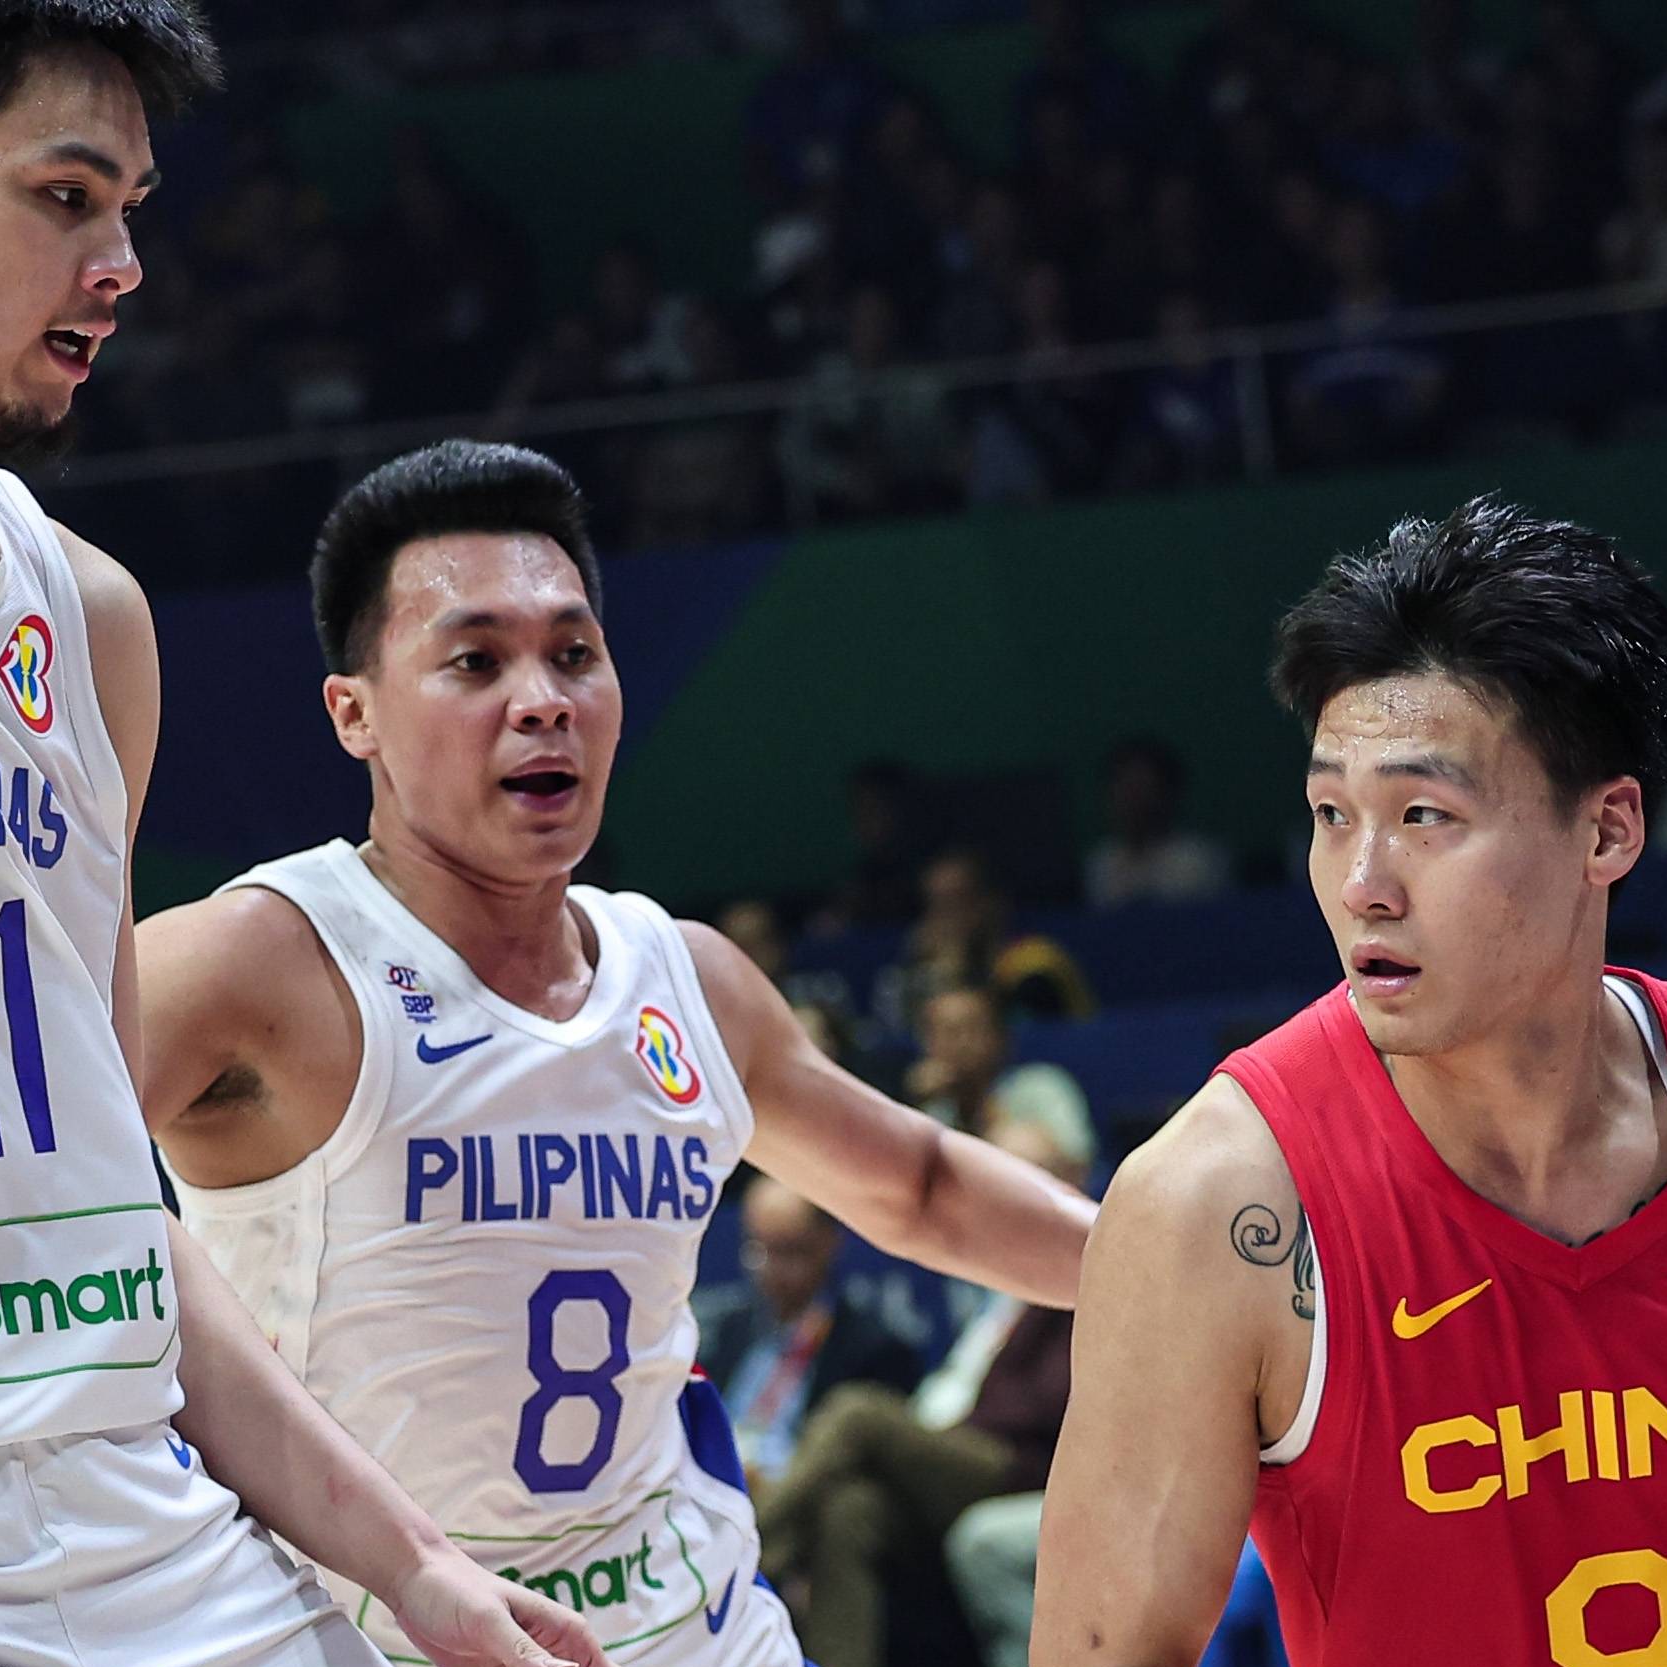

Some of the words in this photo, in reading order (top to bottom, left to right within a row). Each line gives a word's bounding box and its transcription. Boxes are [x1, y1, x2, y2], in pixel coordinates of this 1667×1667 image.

[400, 994, 435, 1014] SBP
[405, 1132, 714, 1223] PILIPINAS
[514, 1269, 632, 1494] 8
